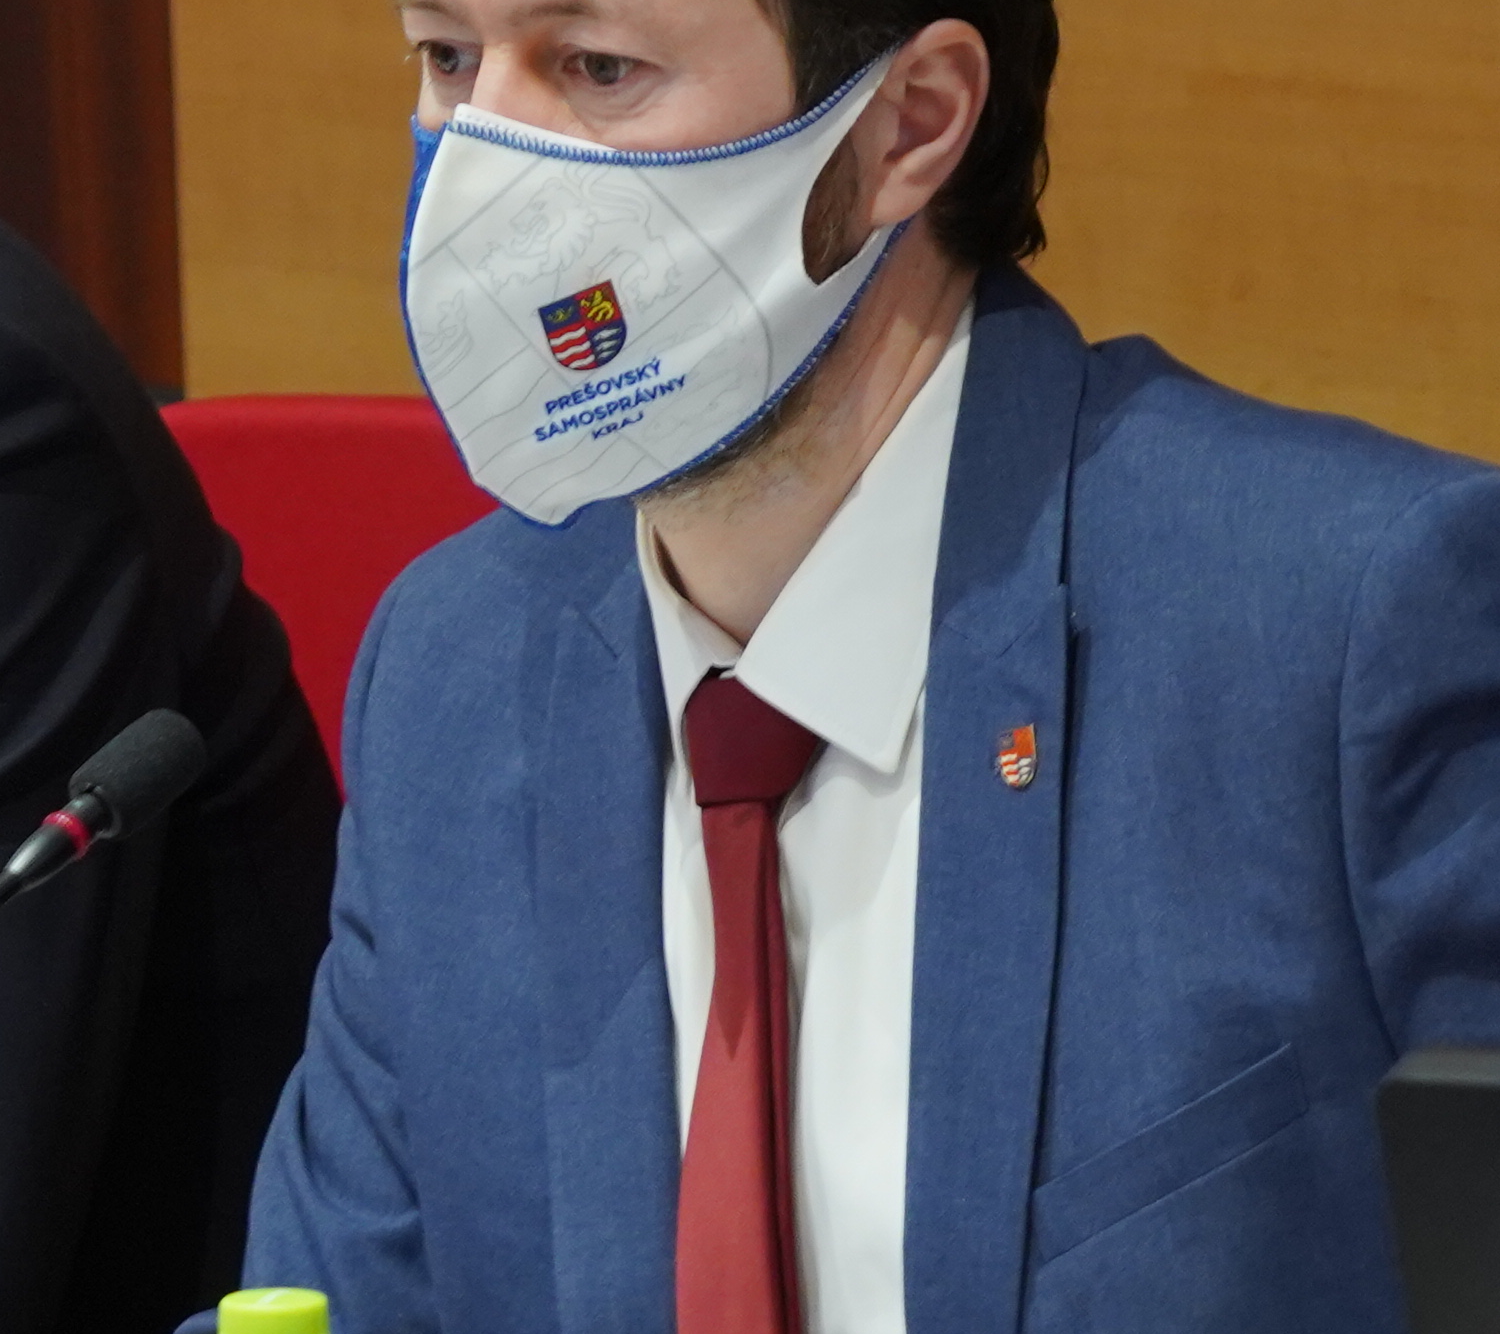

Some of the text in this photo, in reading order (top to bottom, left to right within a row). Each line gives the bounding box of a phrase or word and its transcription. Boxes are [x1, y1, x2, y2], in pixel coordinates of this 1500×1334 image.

[534, 373, 687, 442] SAMOSPRÁVNY
[545, 356, 661, 415] PREŠOVSKÝ
[592, 410, 644, 440] KRAJ
